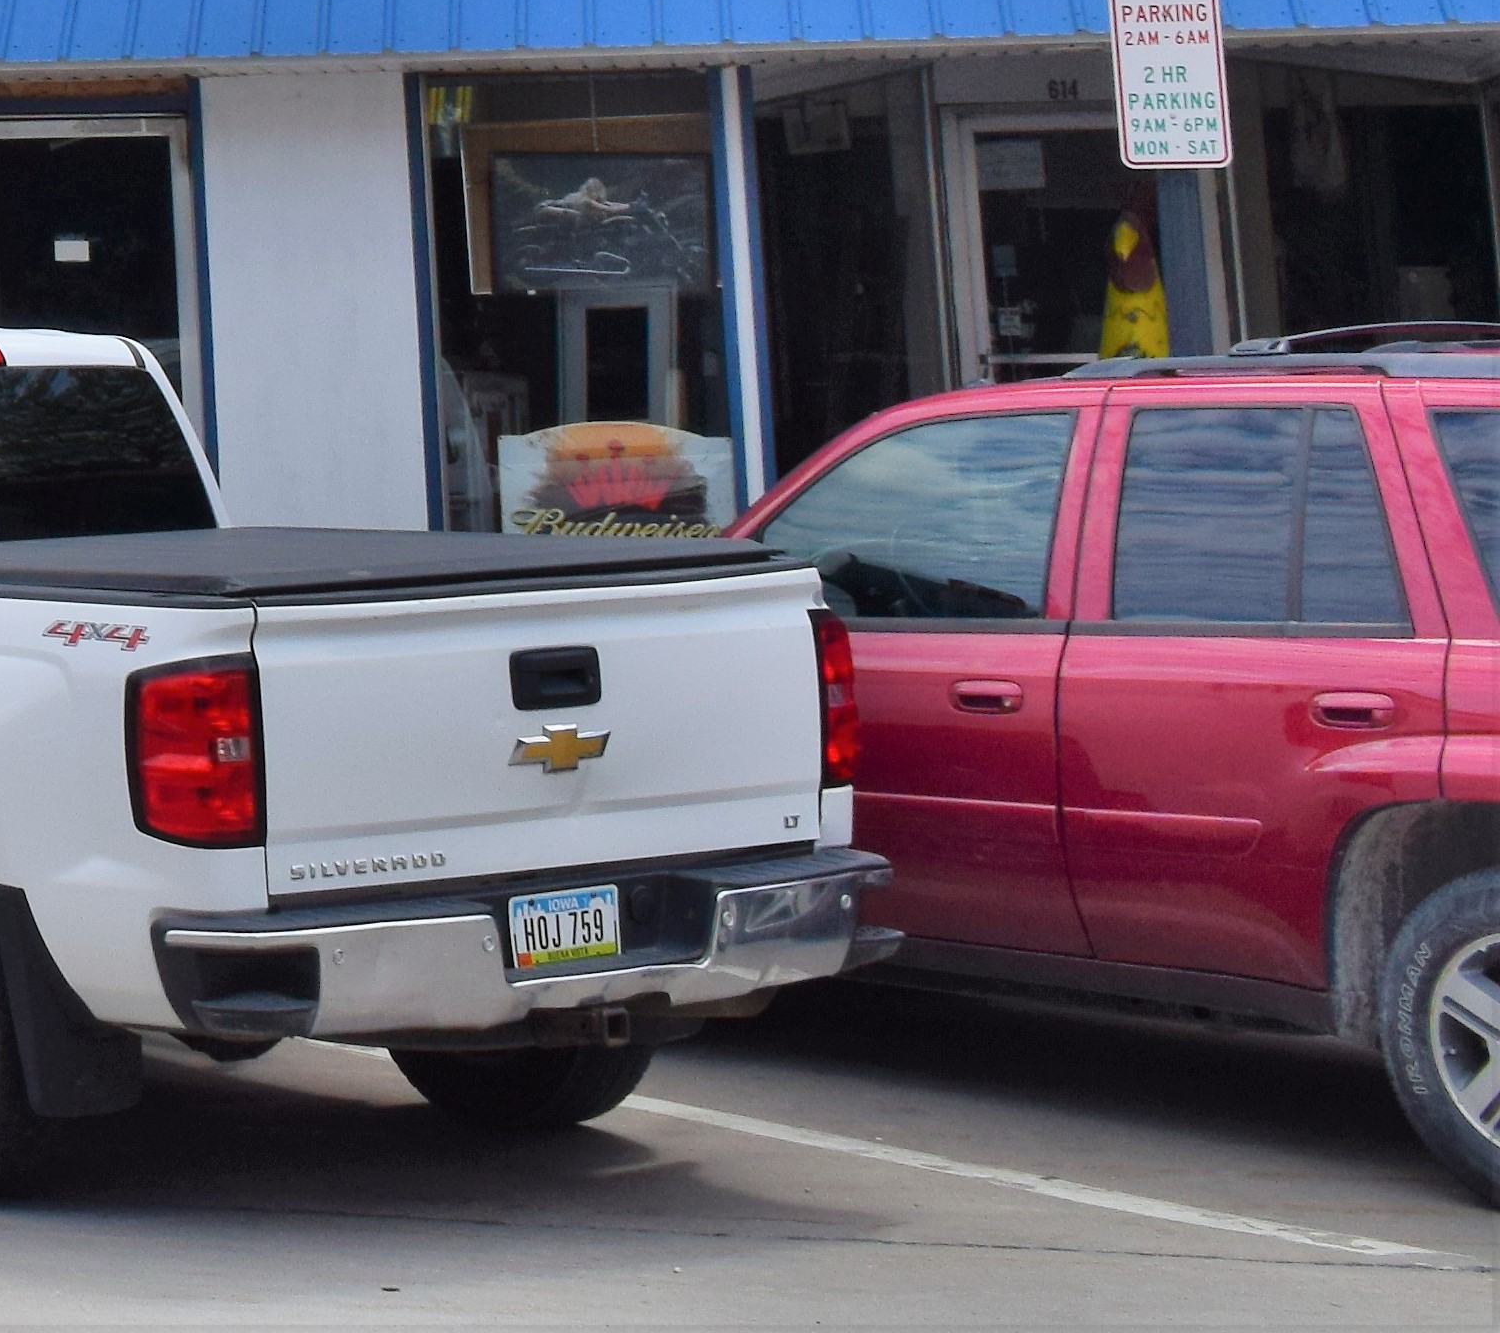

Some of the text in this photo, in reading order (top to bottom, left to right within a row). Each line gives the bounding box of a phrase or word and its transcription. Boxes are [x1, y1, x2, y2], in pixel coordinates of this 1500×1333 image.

[1121, 4, 1208, 24] PARKING
[1124, 31, 1160, 46] 2AM
[1175, 30, 1210, 45] 6AM
[1144, 65, 1188, 84] 2 HR
[1047, 79, 1079, 100] 614
[1128, 91, 1216, 110] PARKING
[1130, 117, 1166, 133] 9AM
[1183, 117, 1218, 132] 6PM
[1133, 140, 1169, 156] MON
[1188, 139, 1218, 155] SAT
[510, 507, 723, 538] Budweiser
[783, 813, 800, 828] LT
[289, 850, 447, 881] SILVERADO
[548, 894, 579, 912] IOWA
[524, 908, 604, 952] HOJ 759
[1397, 941, 1434, 1097] IRONMAN
